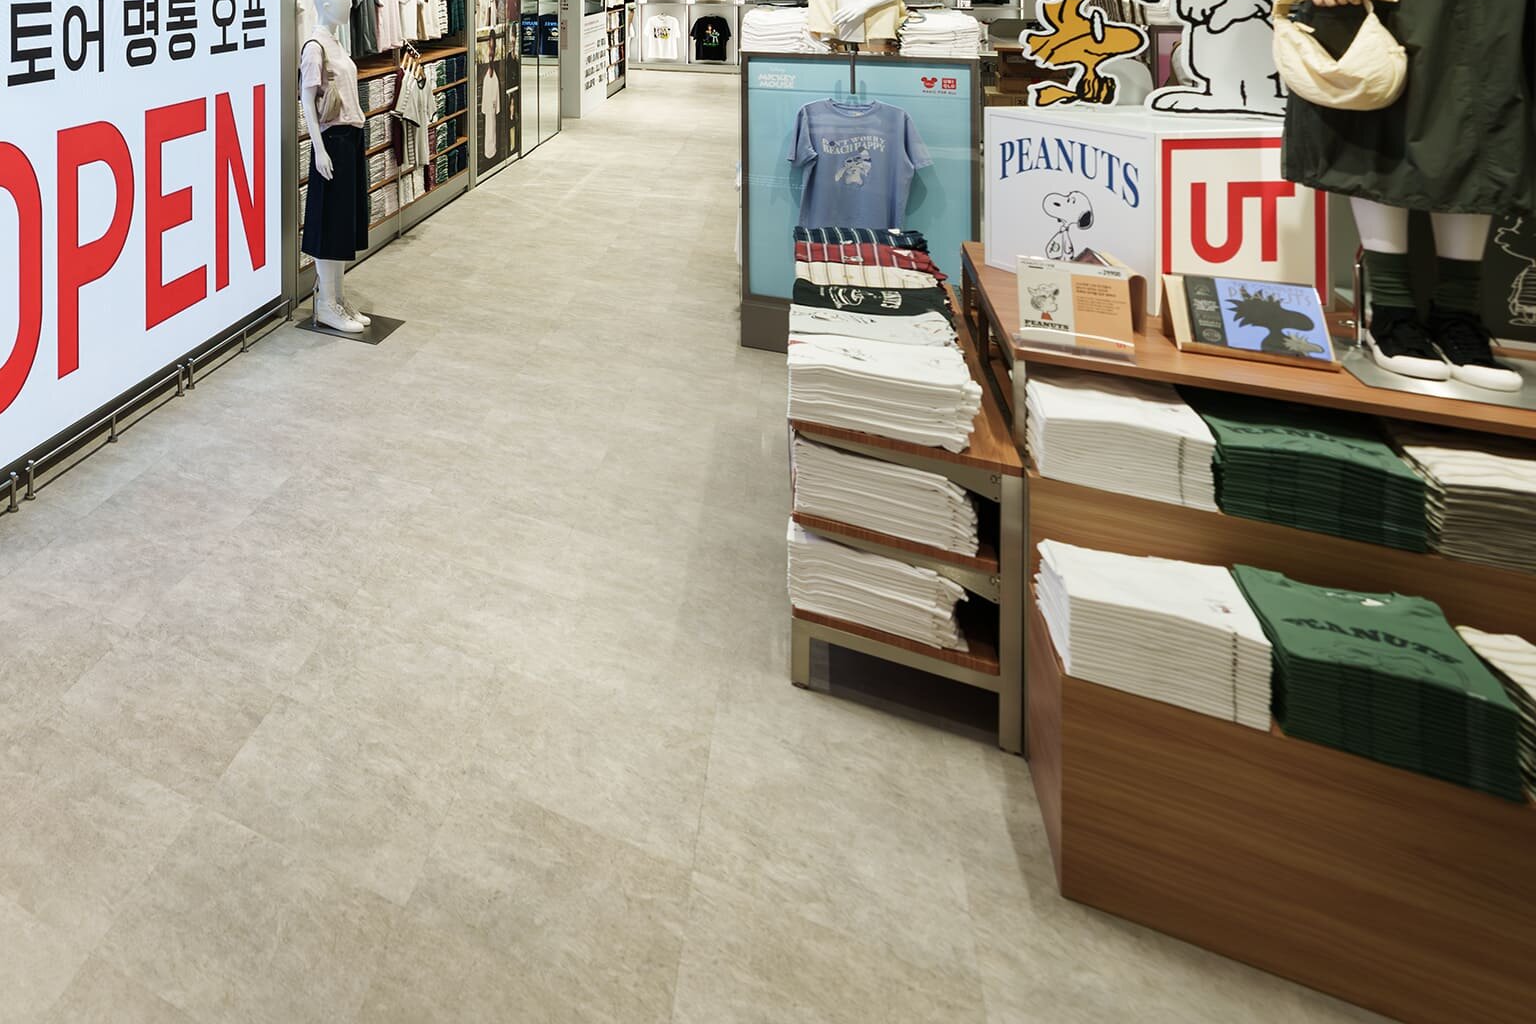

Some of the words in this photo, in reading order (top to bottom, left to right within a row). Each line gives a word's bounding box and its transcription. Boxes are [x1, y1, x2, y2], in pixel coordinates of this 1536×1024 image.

[999, 136, 1140, 209] PEANUTS
[1190, 180, 1296, 264] UT
[1024, 319, 1069, 330] PEANUTS
[1280, 616, 1463, 665] PEANUTS
